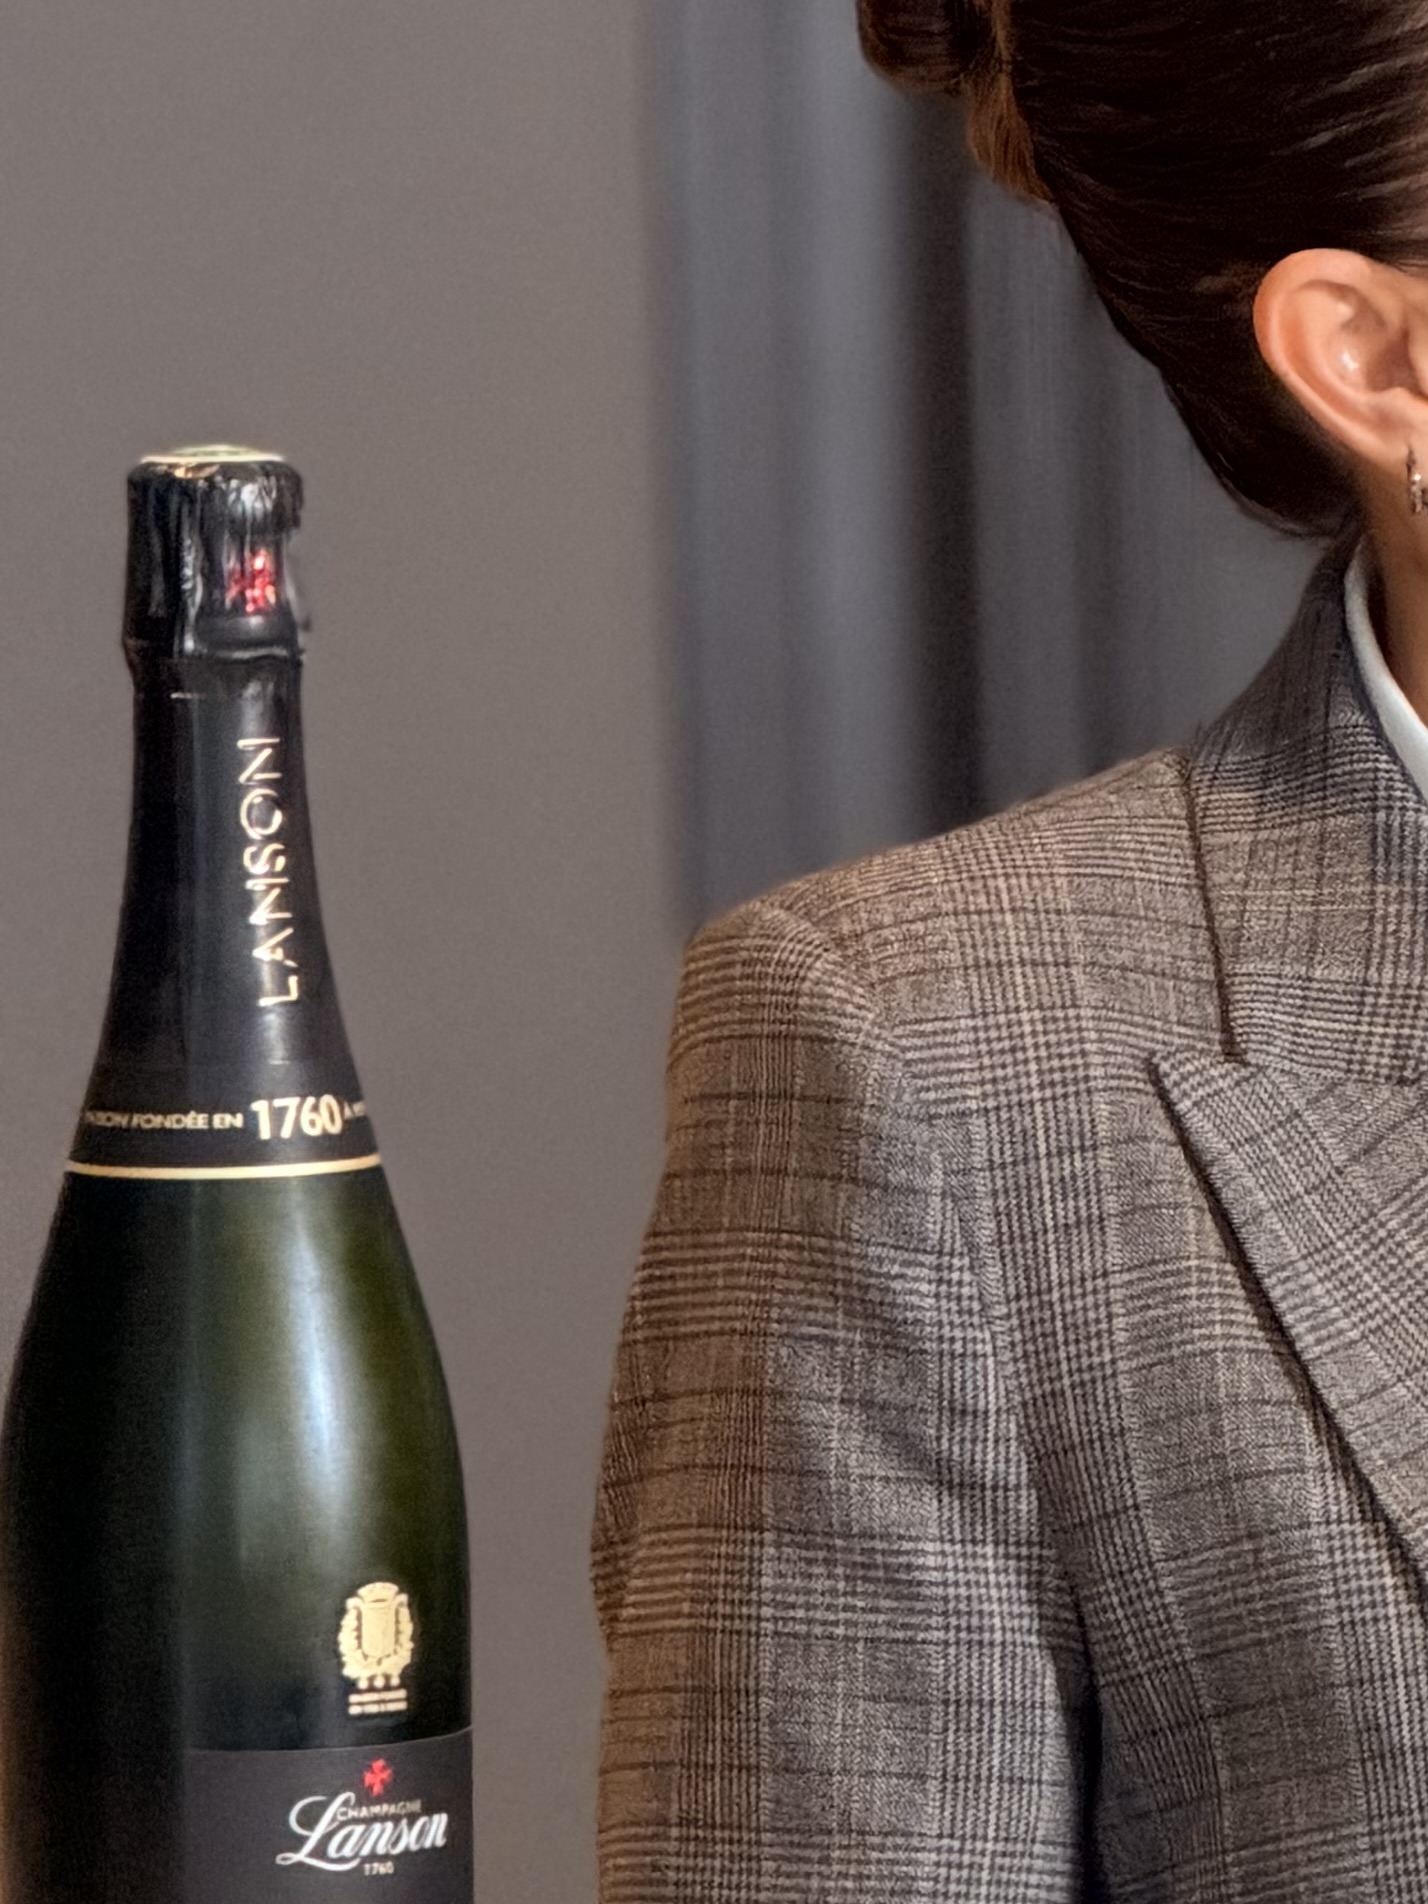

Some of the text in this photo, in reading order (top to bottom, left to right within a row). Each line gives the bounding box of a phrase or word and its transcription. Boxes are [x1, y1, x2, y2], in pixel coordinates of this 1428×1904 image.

[236, 737, 298, 1006] LANSON
[131, 1110, 209, 1129] FONDÉE
[213, 1112, 244, 1128] EN
[251, 1094, 342, 1140] 1760
[275, 1791, 449, 1872] Lanson
[336, 1799, 422, 1821] CHAMPAGNE
[364, 1860, 394, 1876] 1760
